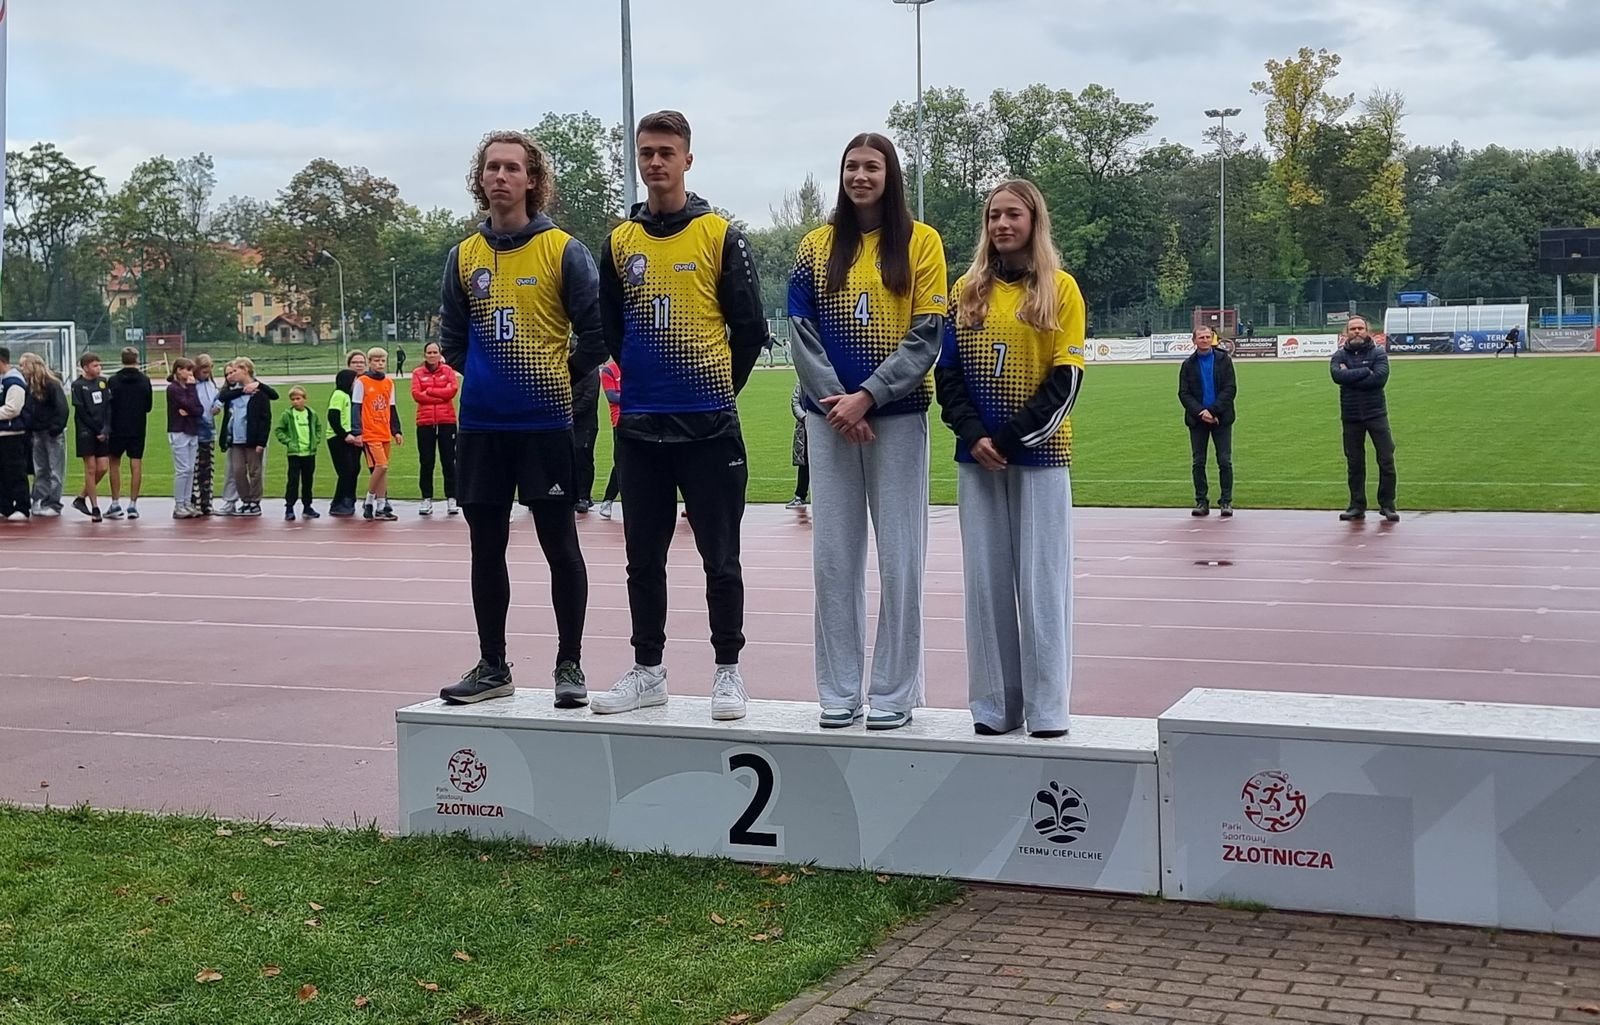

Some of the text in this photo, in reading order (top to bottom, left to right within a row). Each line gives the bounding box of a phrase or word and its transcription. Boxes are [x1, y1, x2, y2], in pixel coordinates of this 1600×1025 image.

[652, 297, 670, 328] 11
[854, 293, 870, 326] 4
[492, 309, 515, 341] 15
[991, 344, 1007, 378] 7
[436, 802, 504, 818] ZŁOTNICZA
[728, 753, 778, 847] 2
[1222, 822, 1242, 831] Park
[1222, 832, 1266, 844] Sportowy
[1052, 848, 1103, 860] CIEPLICKIE
[1222, 844, 1335, 869] ZŁOTNICZA
